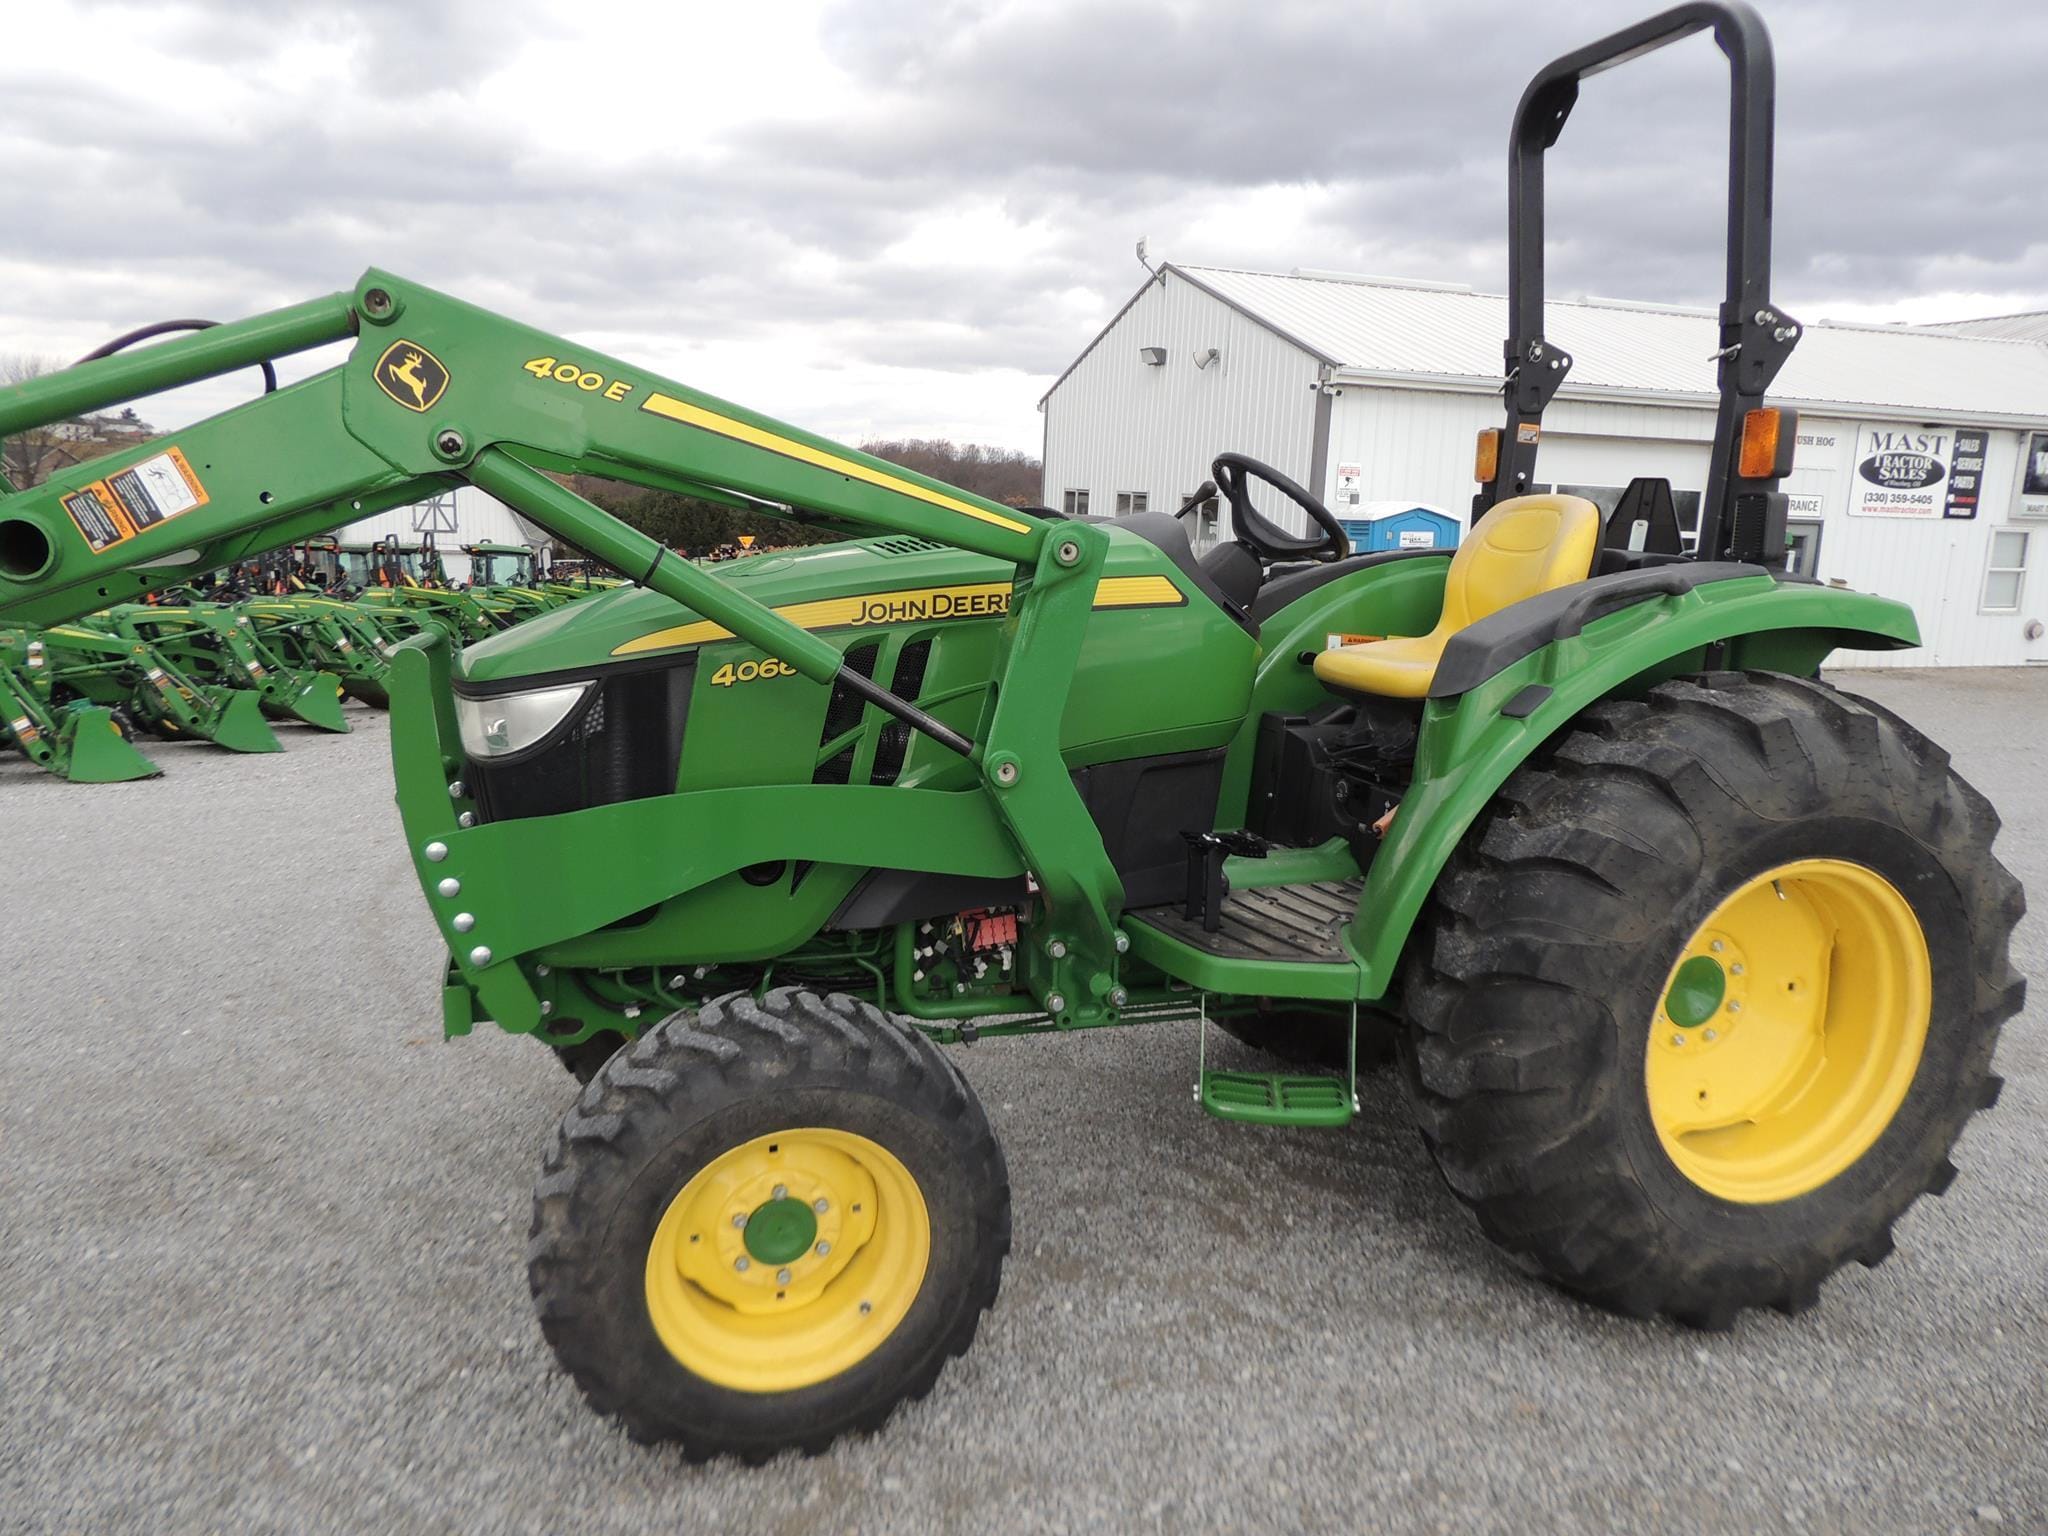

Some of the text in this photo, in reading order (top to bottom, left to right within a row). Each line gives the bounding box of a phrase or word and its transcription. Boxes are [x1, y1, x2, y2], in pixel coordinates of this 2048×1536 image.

[1797, 435, 1835, 447] USH HOG
[1868, 431, 1948, 456] MAST
[1959, 438, 1981, 453] SALES
[1874, 454, 1934, 470] TRACTOR
[1956, 457, 1984, 471] SERVICE
[177, 460, 203, 498] WARNING
[1878, 467, 1928, 481] SALES
[1863, 492, 1933, 504] (330) 359-5405
[1789, 499, 1819, 512] RANCE
[852, 599, 927, 623] JOHN
